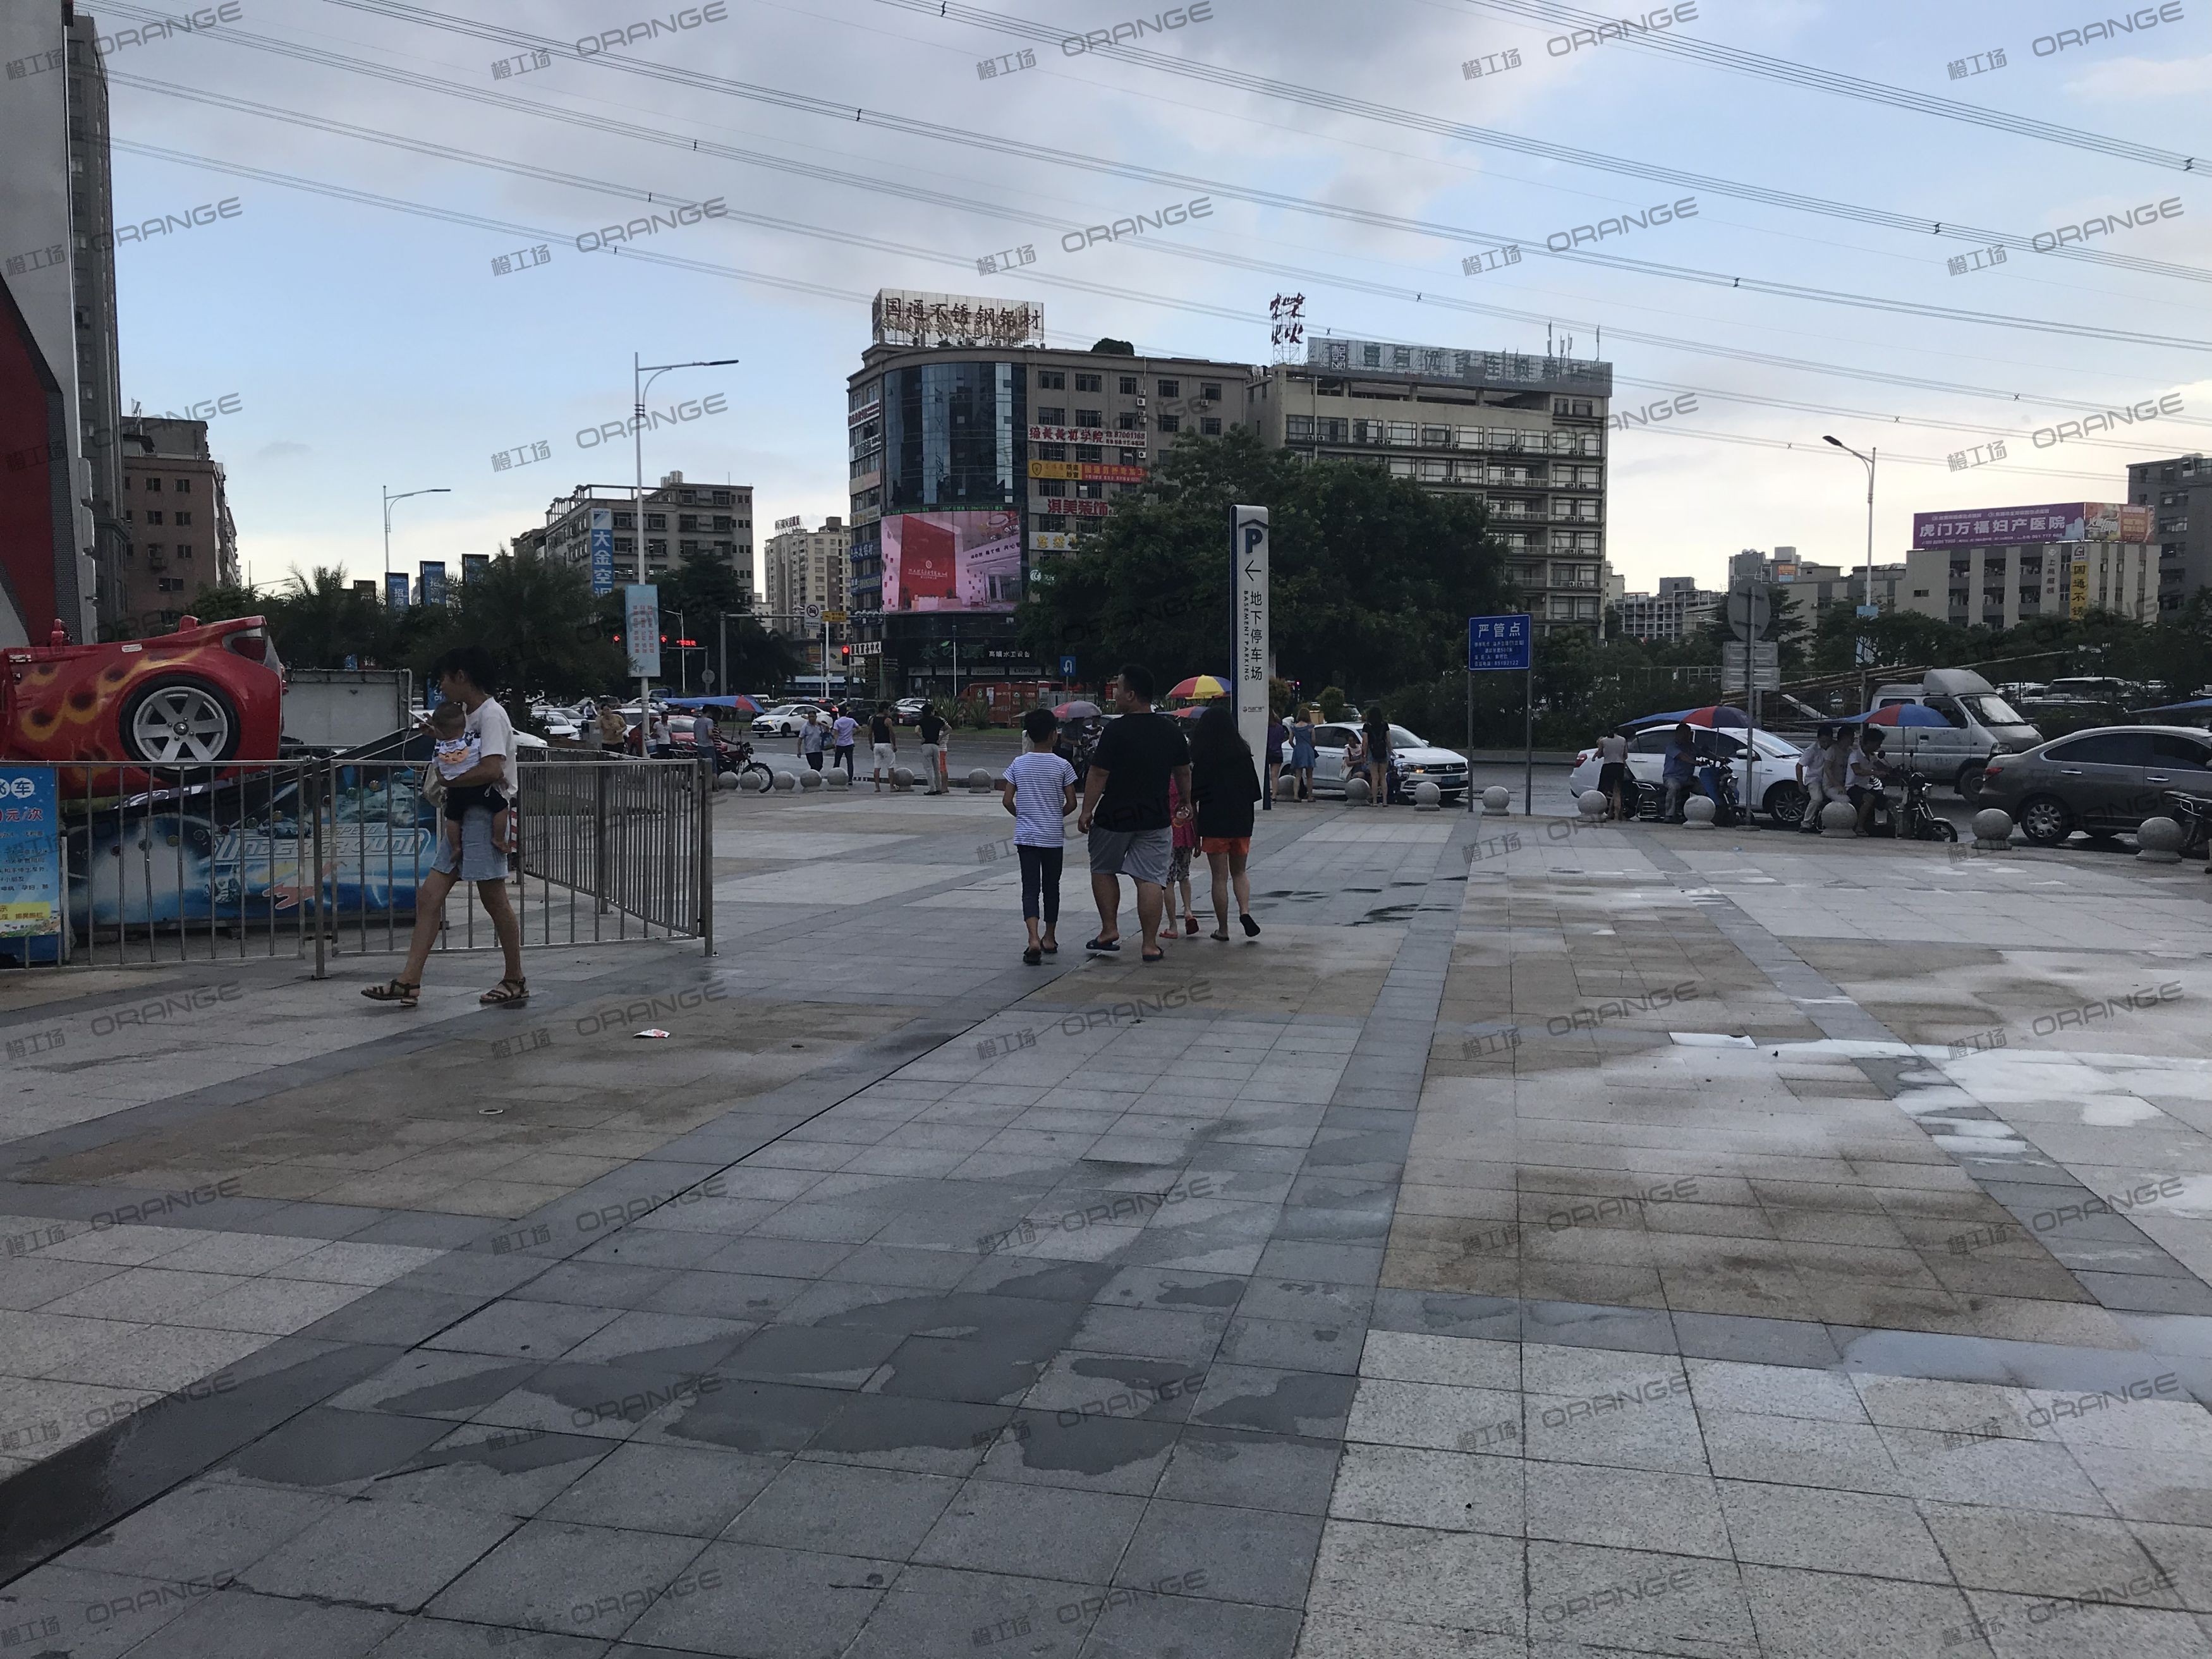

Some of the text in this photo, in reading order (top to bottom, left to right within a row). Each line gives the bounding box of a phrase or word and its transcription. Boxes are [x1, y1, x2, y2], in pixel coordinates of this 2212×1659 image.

[1919, 516, 2066, 537] 虎门万福妇产医院
[1246, 528, 1263, 554] P
[1250, 591, 1263, 681] 地下停车场
[1478, 622, 1521, 638] 严管点
[0, 808, 44, 821] 元/次
